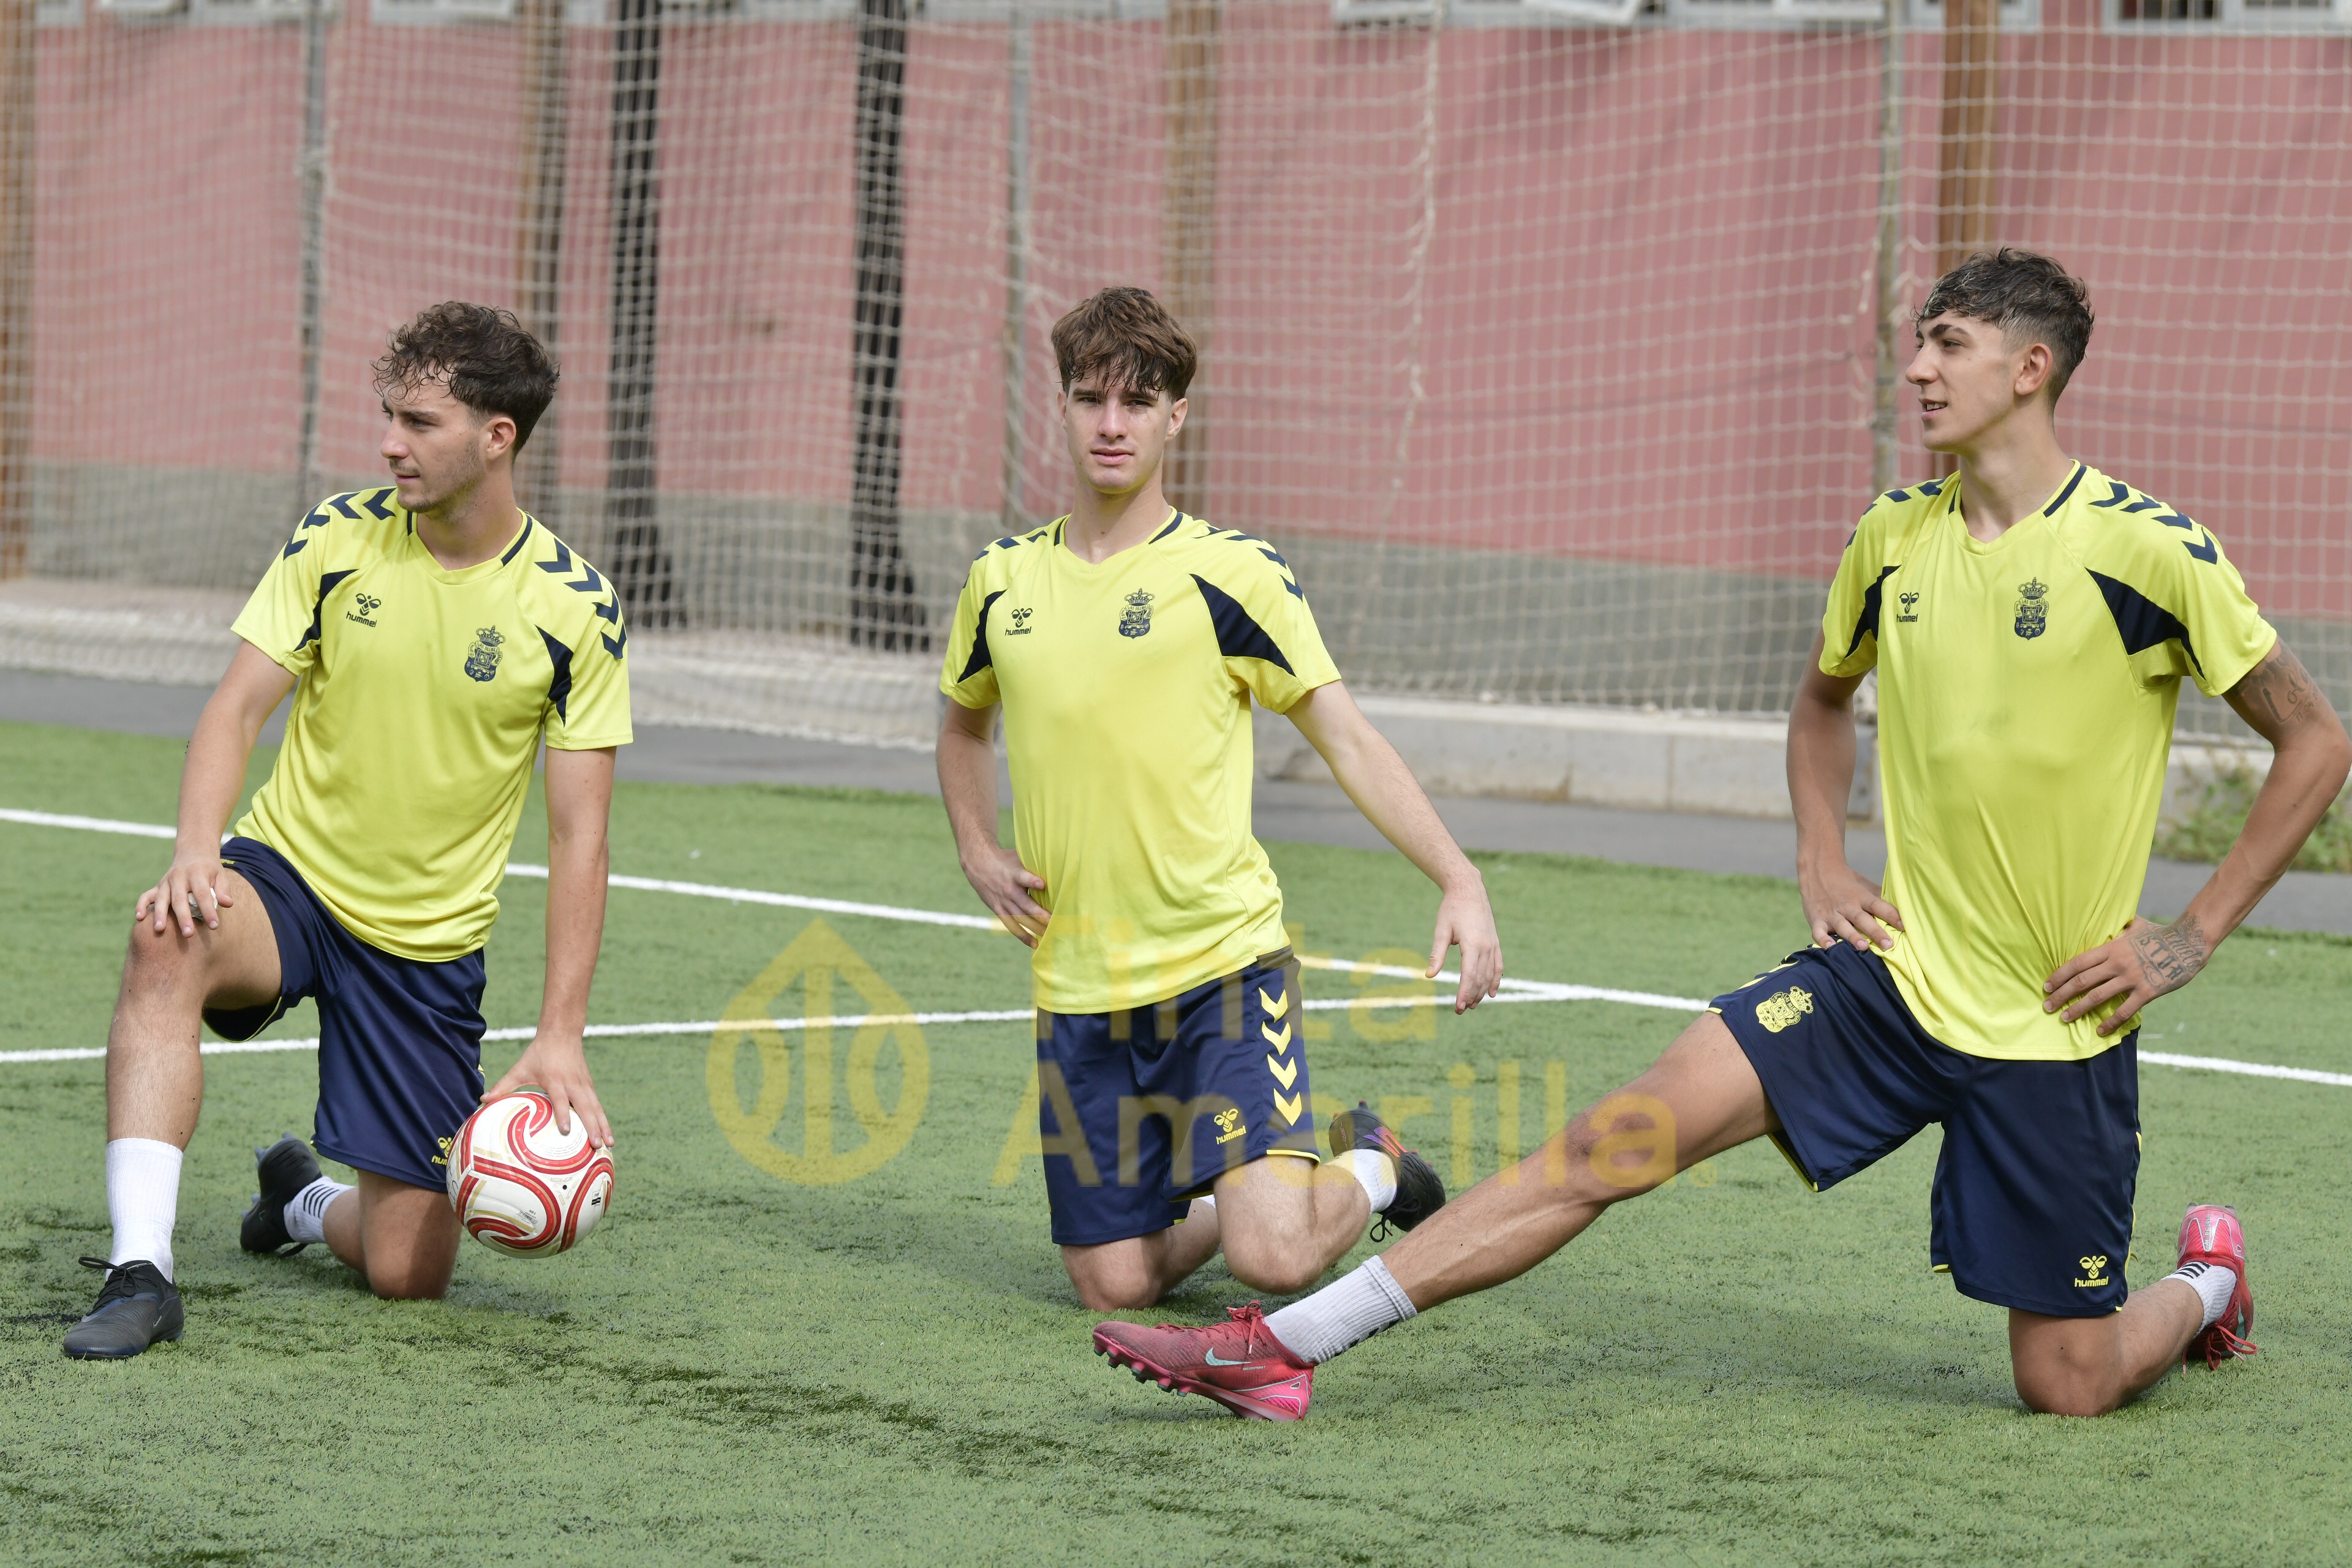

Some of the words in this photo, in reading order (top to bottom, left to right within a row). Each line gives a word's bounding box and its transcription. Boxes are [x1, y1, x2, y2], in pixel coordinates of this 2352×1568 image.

[345, 611, 377, 628] hummel
[1896, 613, 1918, 622] hummel
[1005, 626, 1032, 636] hummel
[1216, 1125, 1246, 1145] hummel
[2074, 1276, 2109, 1287] hummel
